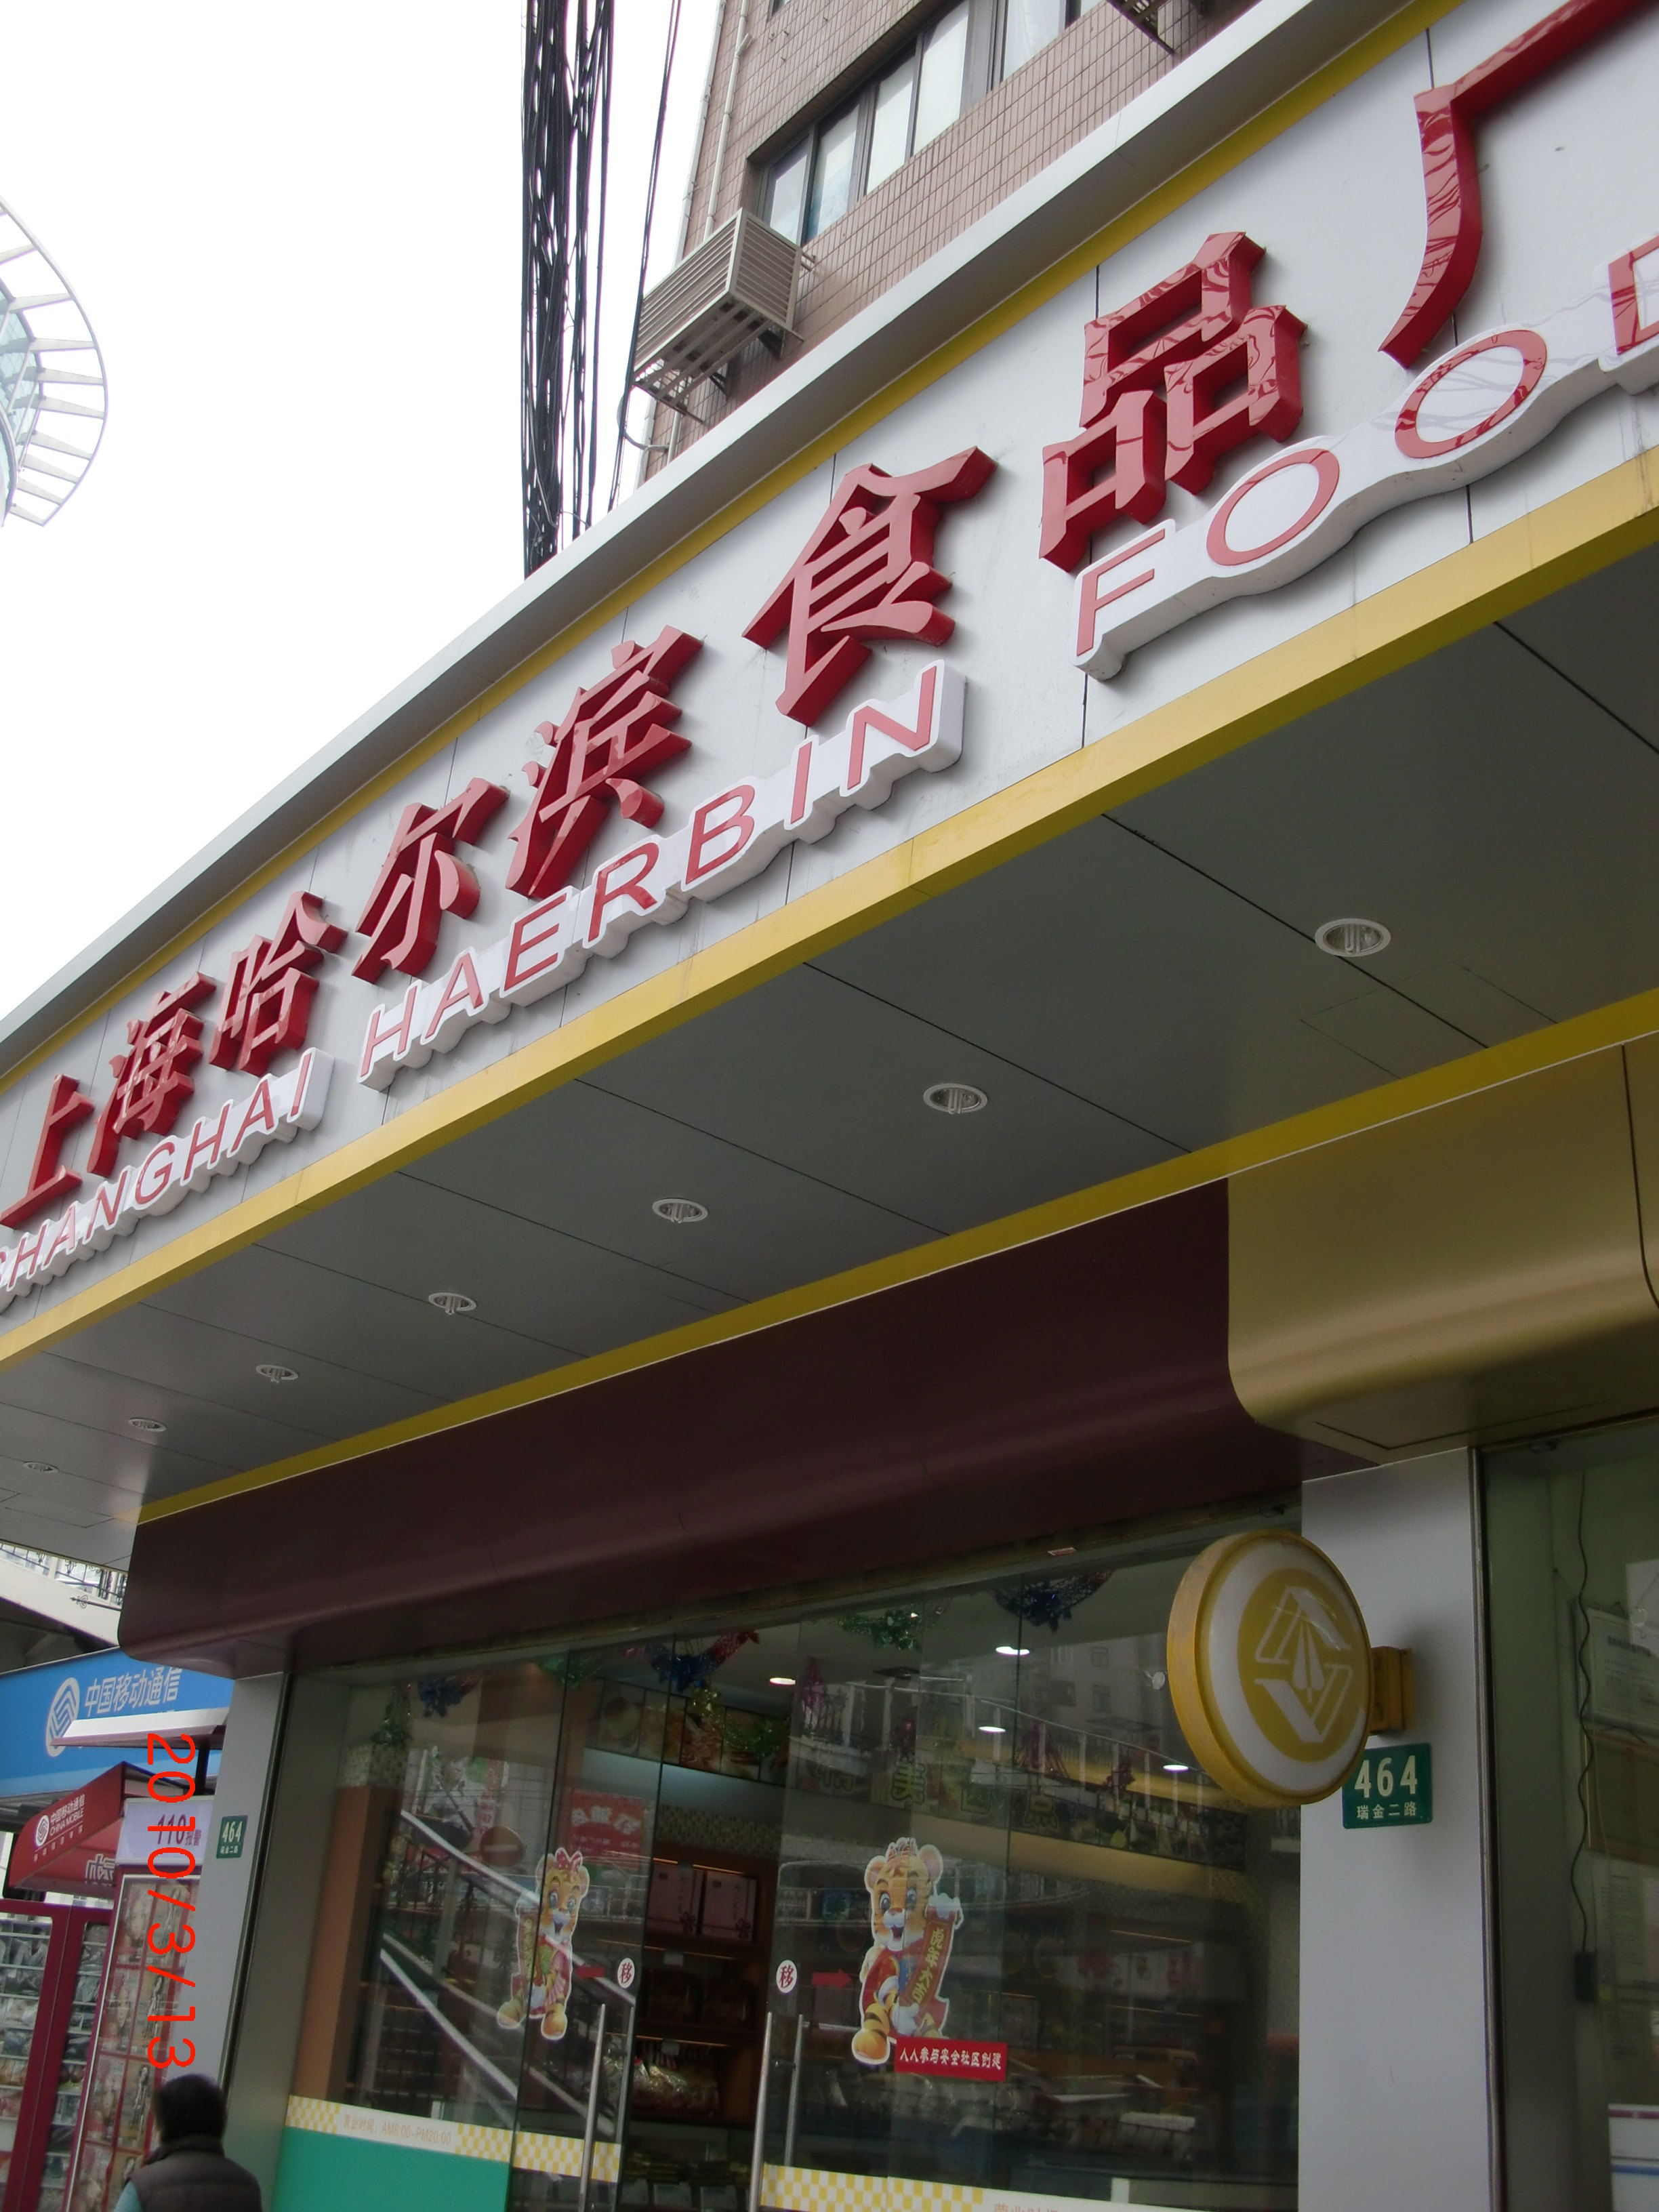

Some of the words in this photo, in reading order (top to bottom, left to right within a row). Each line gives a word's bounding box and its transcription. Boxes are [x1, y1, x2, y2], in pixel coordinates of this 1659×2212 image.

[0, 0, 1659, 1230] 上海哈尔滨食品厂
[361, 665, 938, 1078] HAERBIN
[84, 1666, 183, 1717] 中国移动通信
[1354, 1755, 1418, 1798] 464
[49, 1819, 66, 1837] CHINA
[66, 1807, 84, 1827] MOBILE
[1357, 1801, 1416, 1820] 瑞金二路
[222, 1820, 243, 1843] 464
[899, 2045, 1002, 2070] 人人参与安全社区创建
